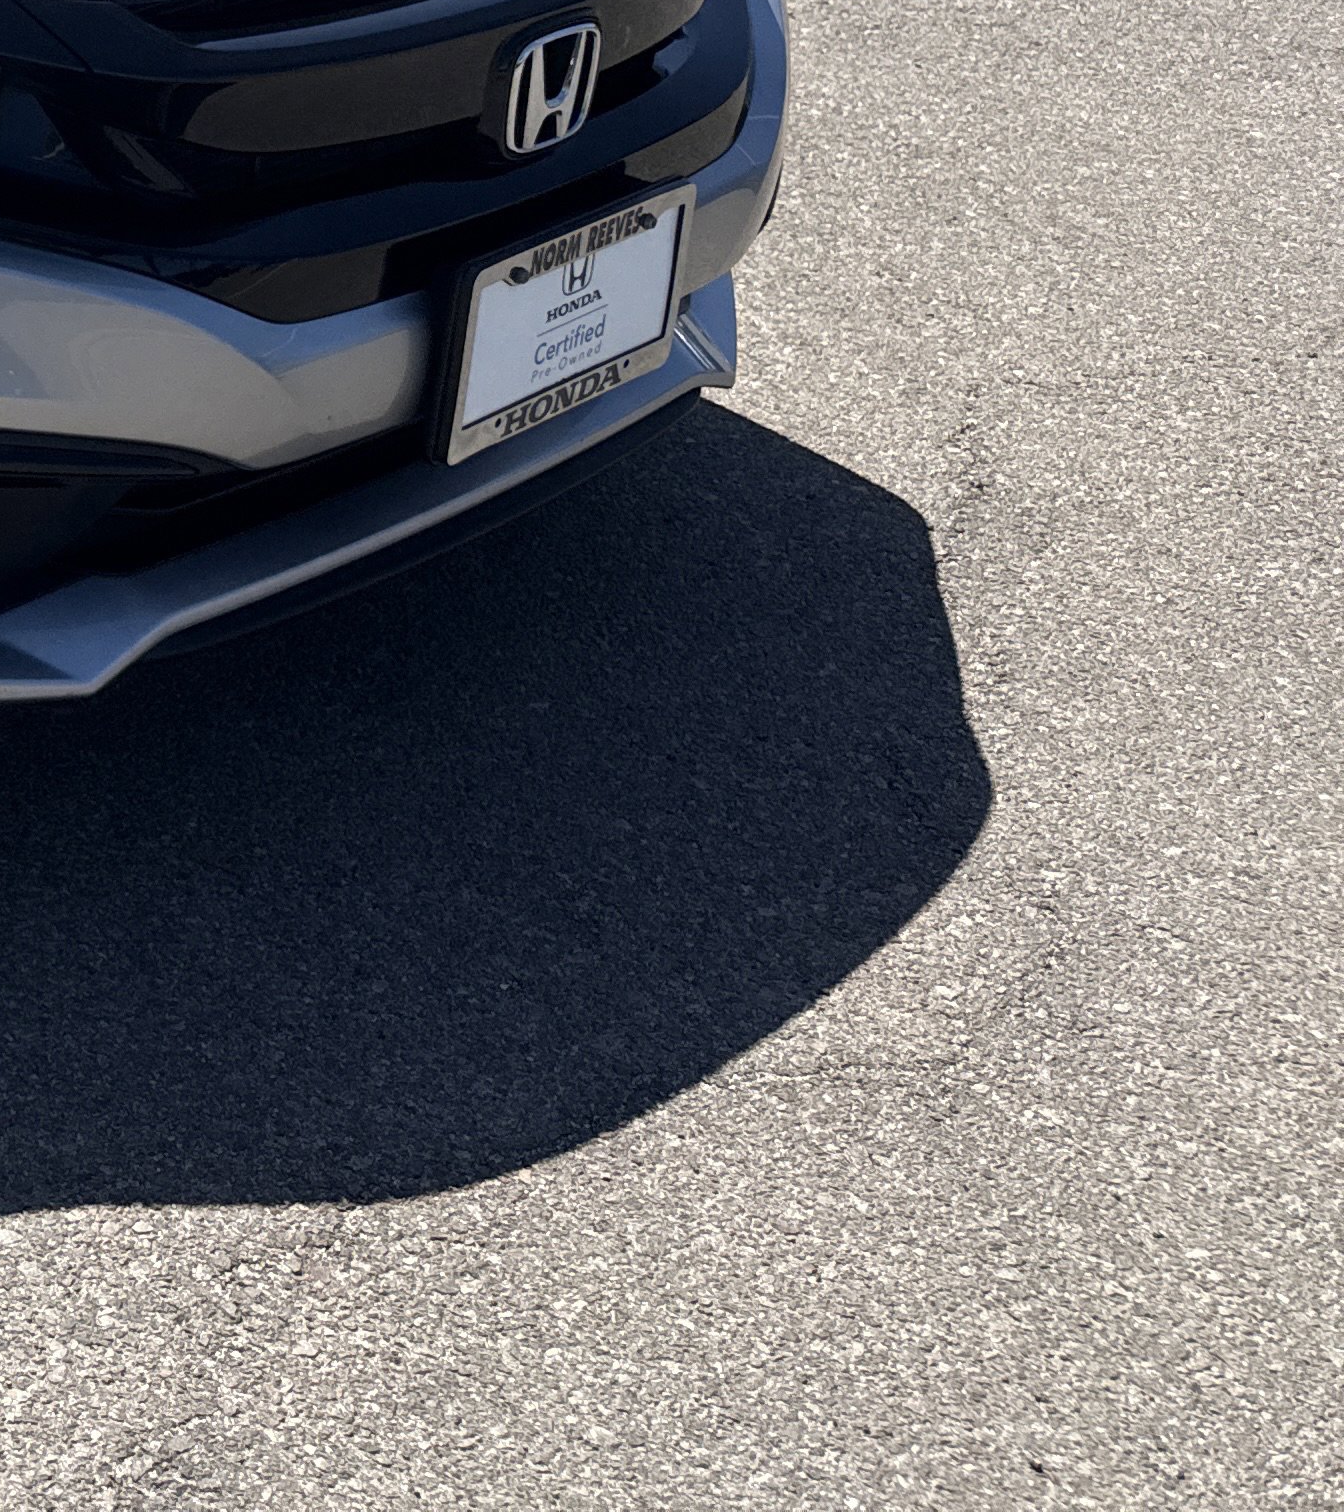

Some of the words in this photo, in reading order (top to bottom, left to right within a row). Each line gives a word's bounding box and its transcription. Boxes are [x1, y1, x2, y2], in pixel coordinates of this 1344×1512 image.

[529, 231, 583, 277] NORM
[585, 206, 644, 253] REEVES
[545, 289, 602, 324] HONDA
[530, 339, 602, 384] Pre-Owned
[534, 313, 607, 365] Certified
[500, 363, 622, 438] HONDA
